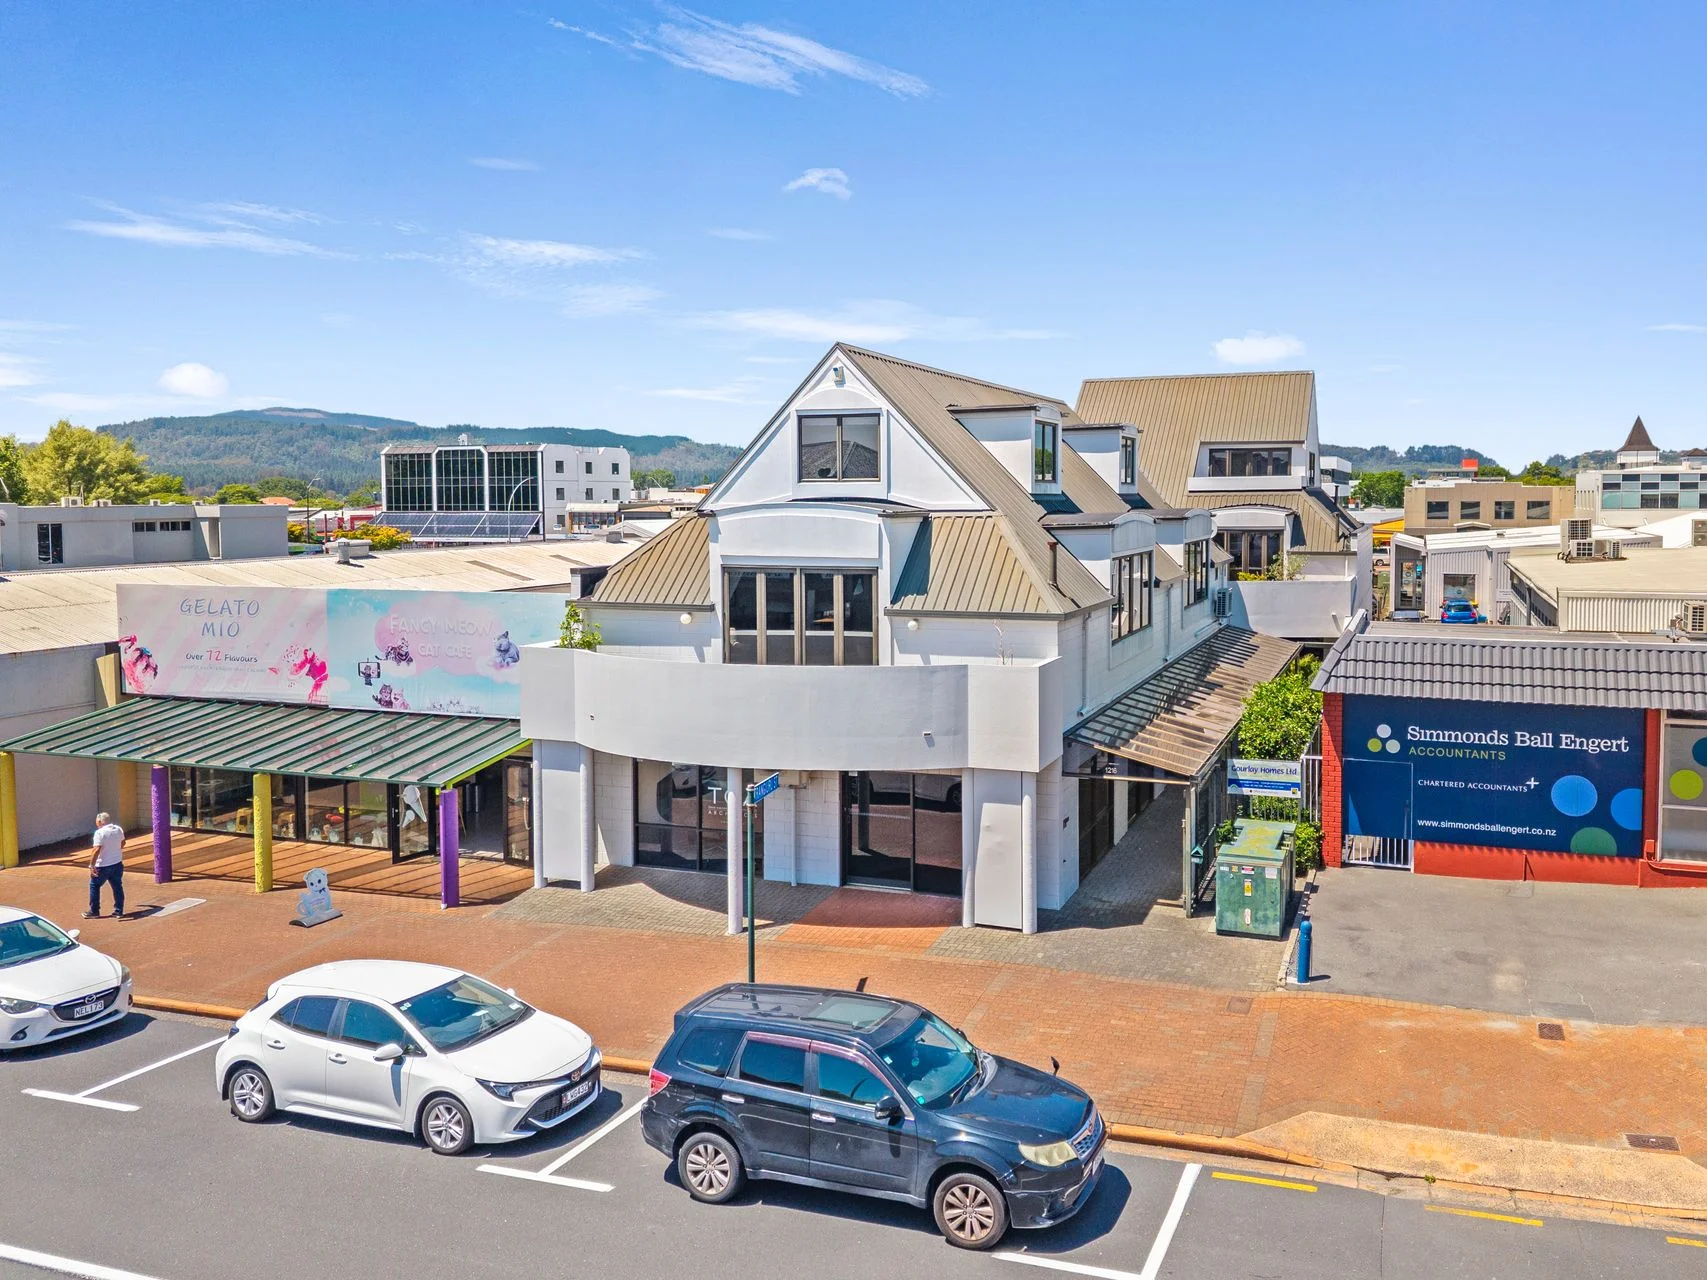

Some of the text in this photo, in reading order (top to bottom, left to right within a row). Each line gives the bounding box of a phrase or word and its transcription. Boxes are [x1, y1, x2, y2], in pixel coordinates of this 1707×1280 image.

[180, 598, 260, 616] GELATO
[201, 621, 240, 637] MIO
[389, 615, 493, 636] FANCY MEOW
[185, 652, 203, 661] Over
[224, 653, 258, 663] Flavours
[418, 643, 441, 658] CAT
[1407, 725, 1630, 754] Simmonds Ball Engert
[1408, 746, 1506, 761] ACCOUNTANTS
[1260, 766, 1284, 775] Homes
[1286, 767, 1297, 775] Ltd
[1418, 779, 1528, 792] CHARTERED ACCOUNTANTS
[1417, 818, 1557, 837] www.simmondsballengert.co.nz
